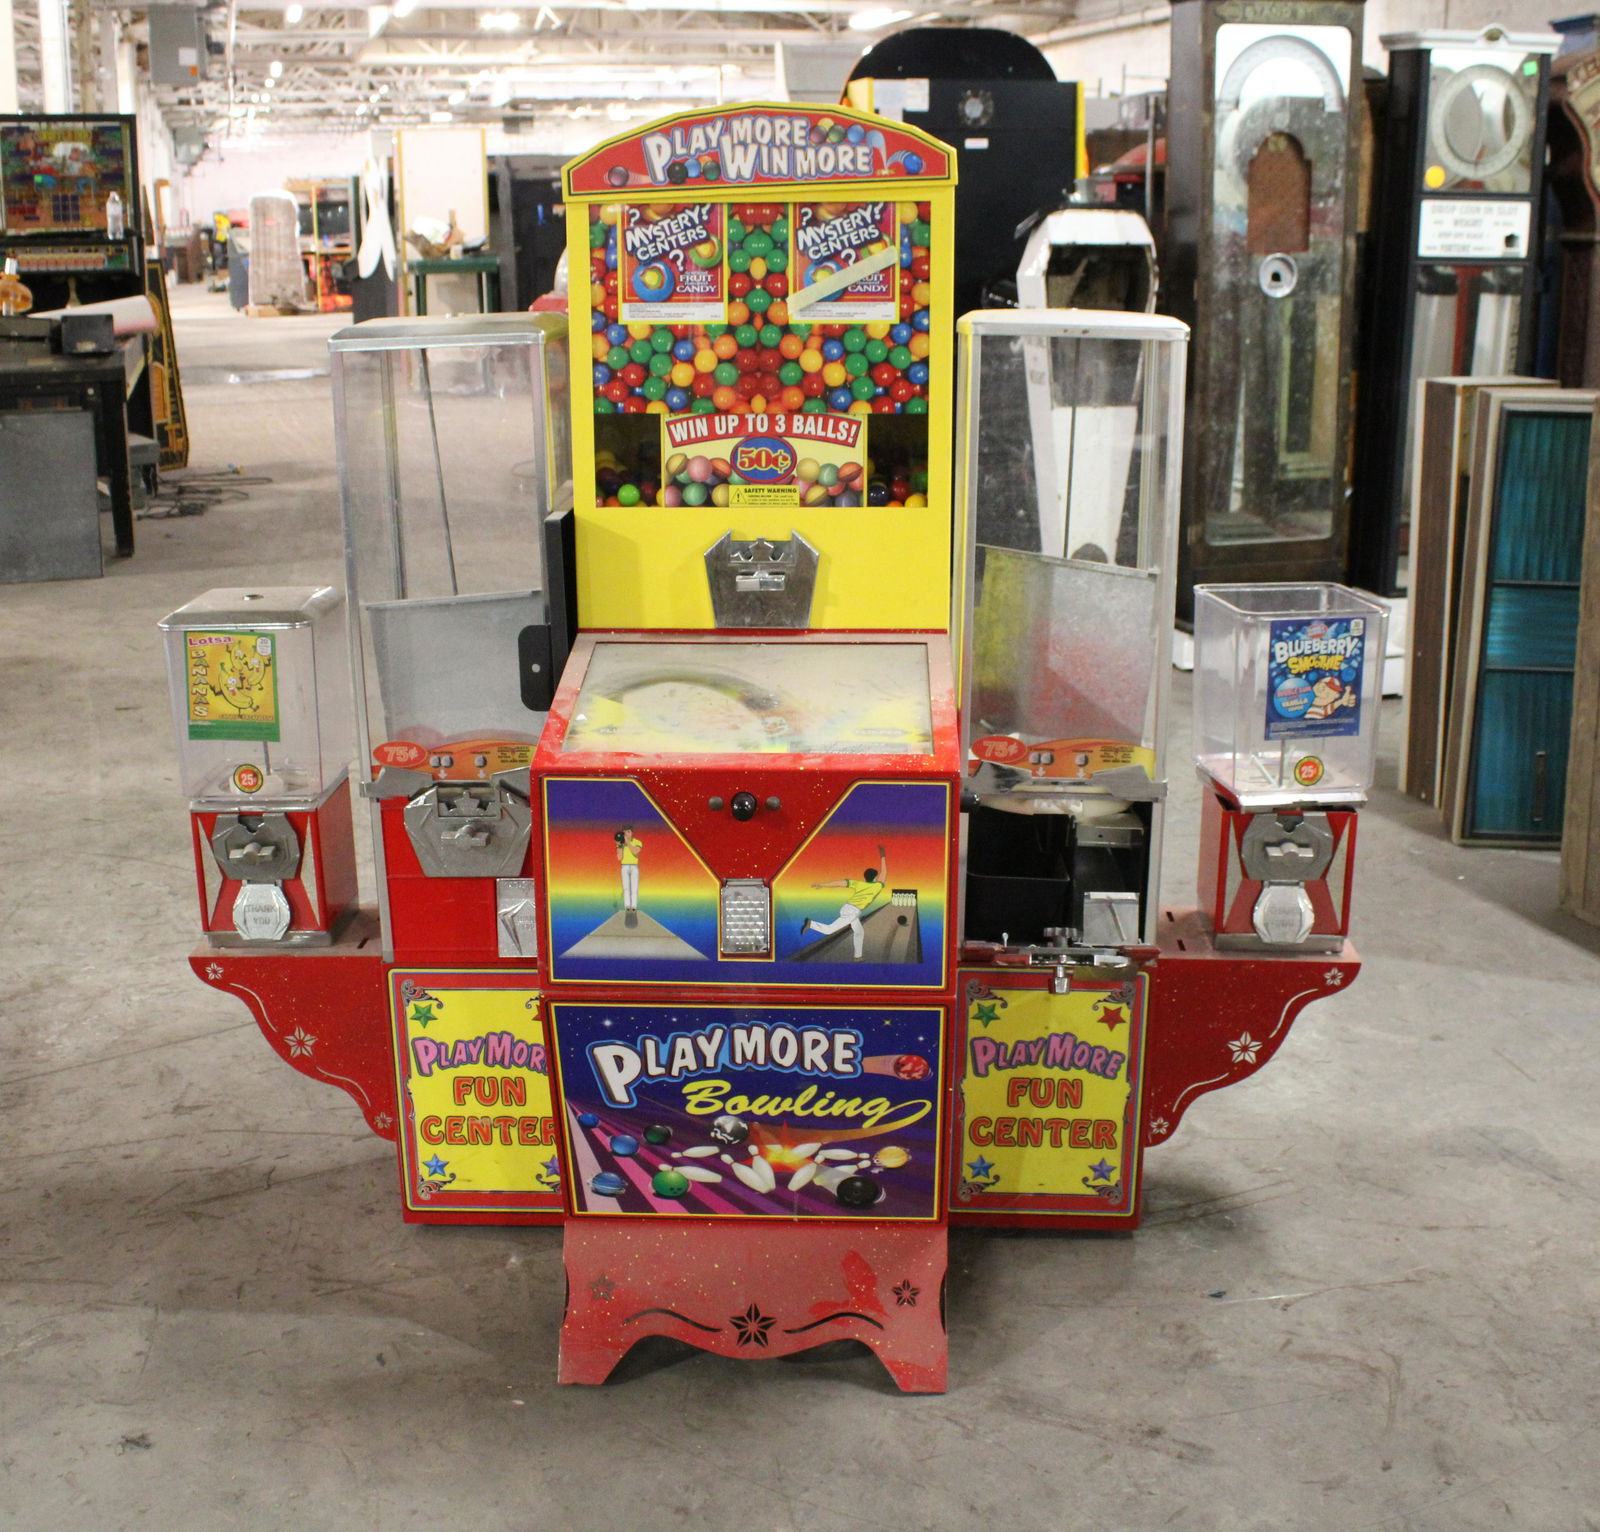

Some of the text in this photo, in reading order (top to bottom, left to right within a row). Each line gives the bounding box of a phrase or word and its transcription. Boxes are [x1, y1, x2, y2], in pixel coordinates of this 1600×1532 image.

[719, 134, 872, 180] WIN MORE
[637, 225, 707, 260] CENTERS
[808, 225, 880, 260] CENTERS
[676, 285, 717, 293] CANDY
[679, 274, 714, 282] FRUIT
[847, 284, 889, 293] CANDY
[670, 413, 857, 443] WIN UP TO 3 BALLS!
[737, 447, 791, 474] 50¢
[188, 635, 233, 646] Lotsa
[1274, 636, 1360, 664] BLUEBERRY
[383, 745, 419, 763] 75¢
[983, 740, 1019, 758] 75¢
[453, 1076, 526, 1106] FUN
[682, 1079, 932, 1129] Bowling
[1007, 1077, 1083, 1108] FUN
[421, 1115, 555, 1146] CENTER
[969, 1116, 1117, 1149] CENTER
